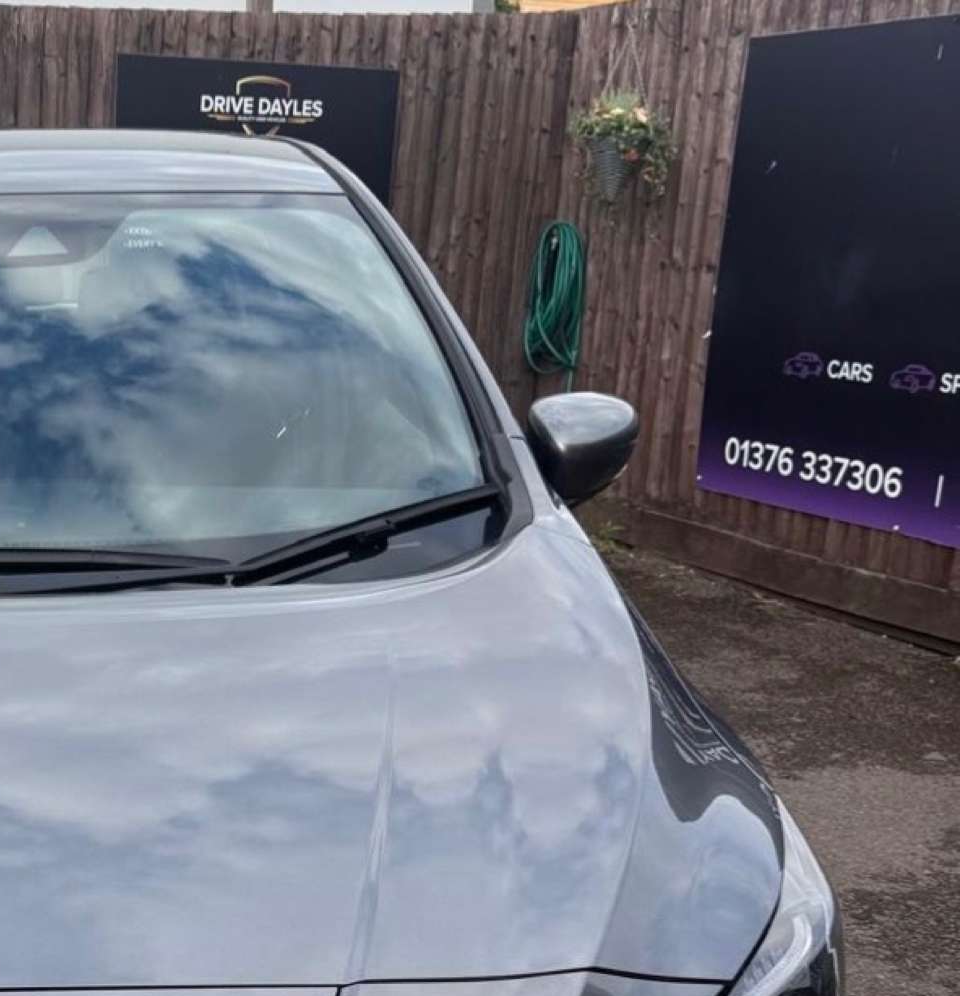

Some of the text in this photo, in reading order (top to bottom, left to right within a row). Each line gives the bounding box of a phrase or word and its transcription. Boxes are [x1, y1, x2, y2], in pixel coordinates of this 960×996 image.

[200, 94, 323, 117] DRIVE DAYLES
[827, 360, 874, 383] CARS
[724, 436, 904, 498] 01376 337306
